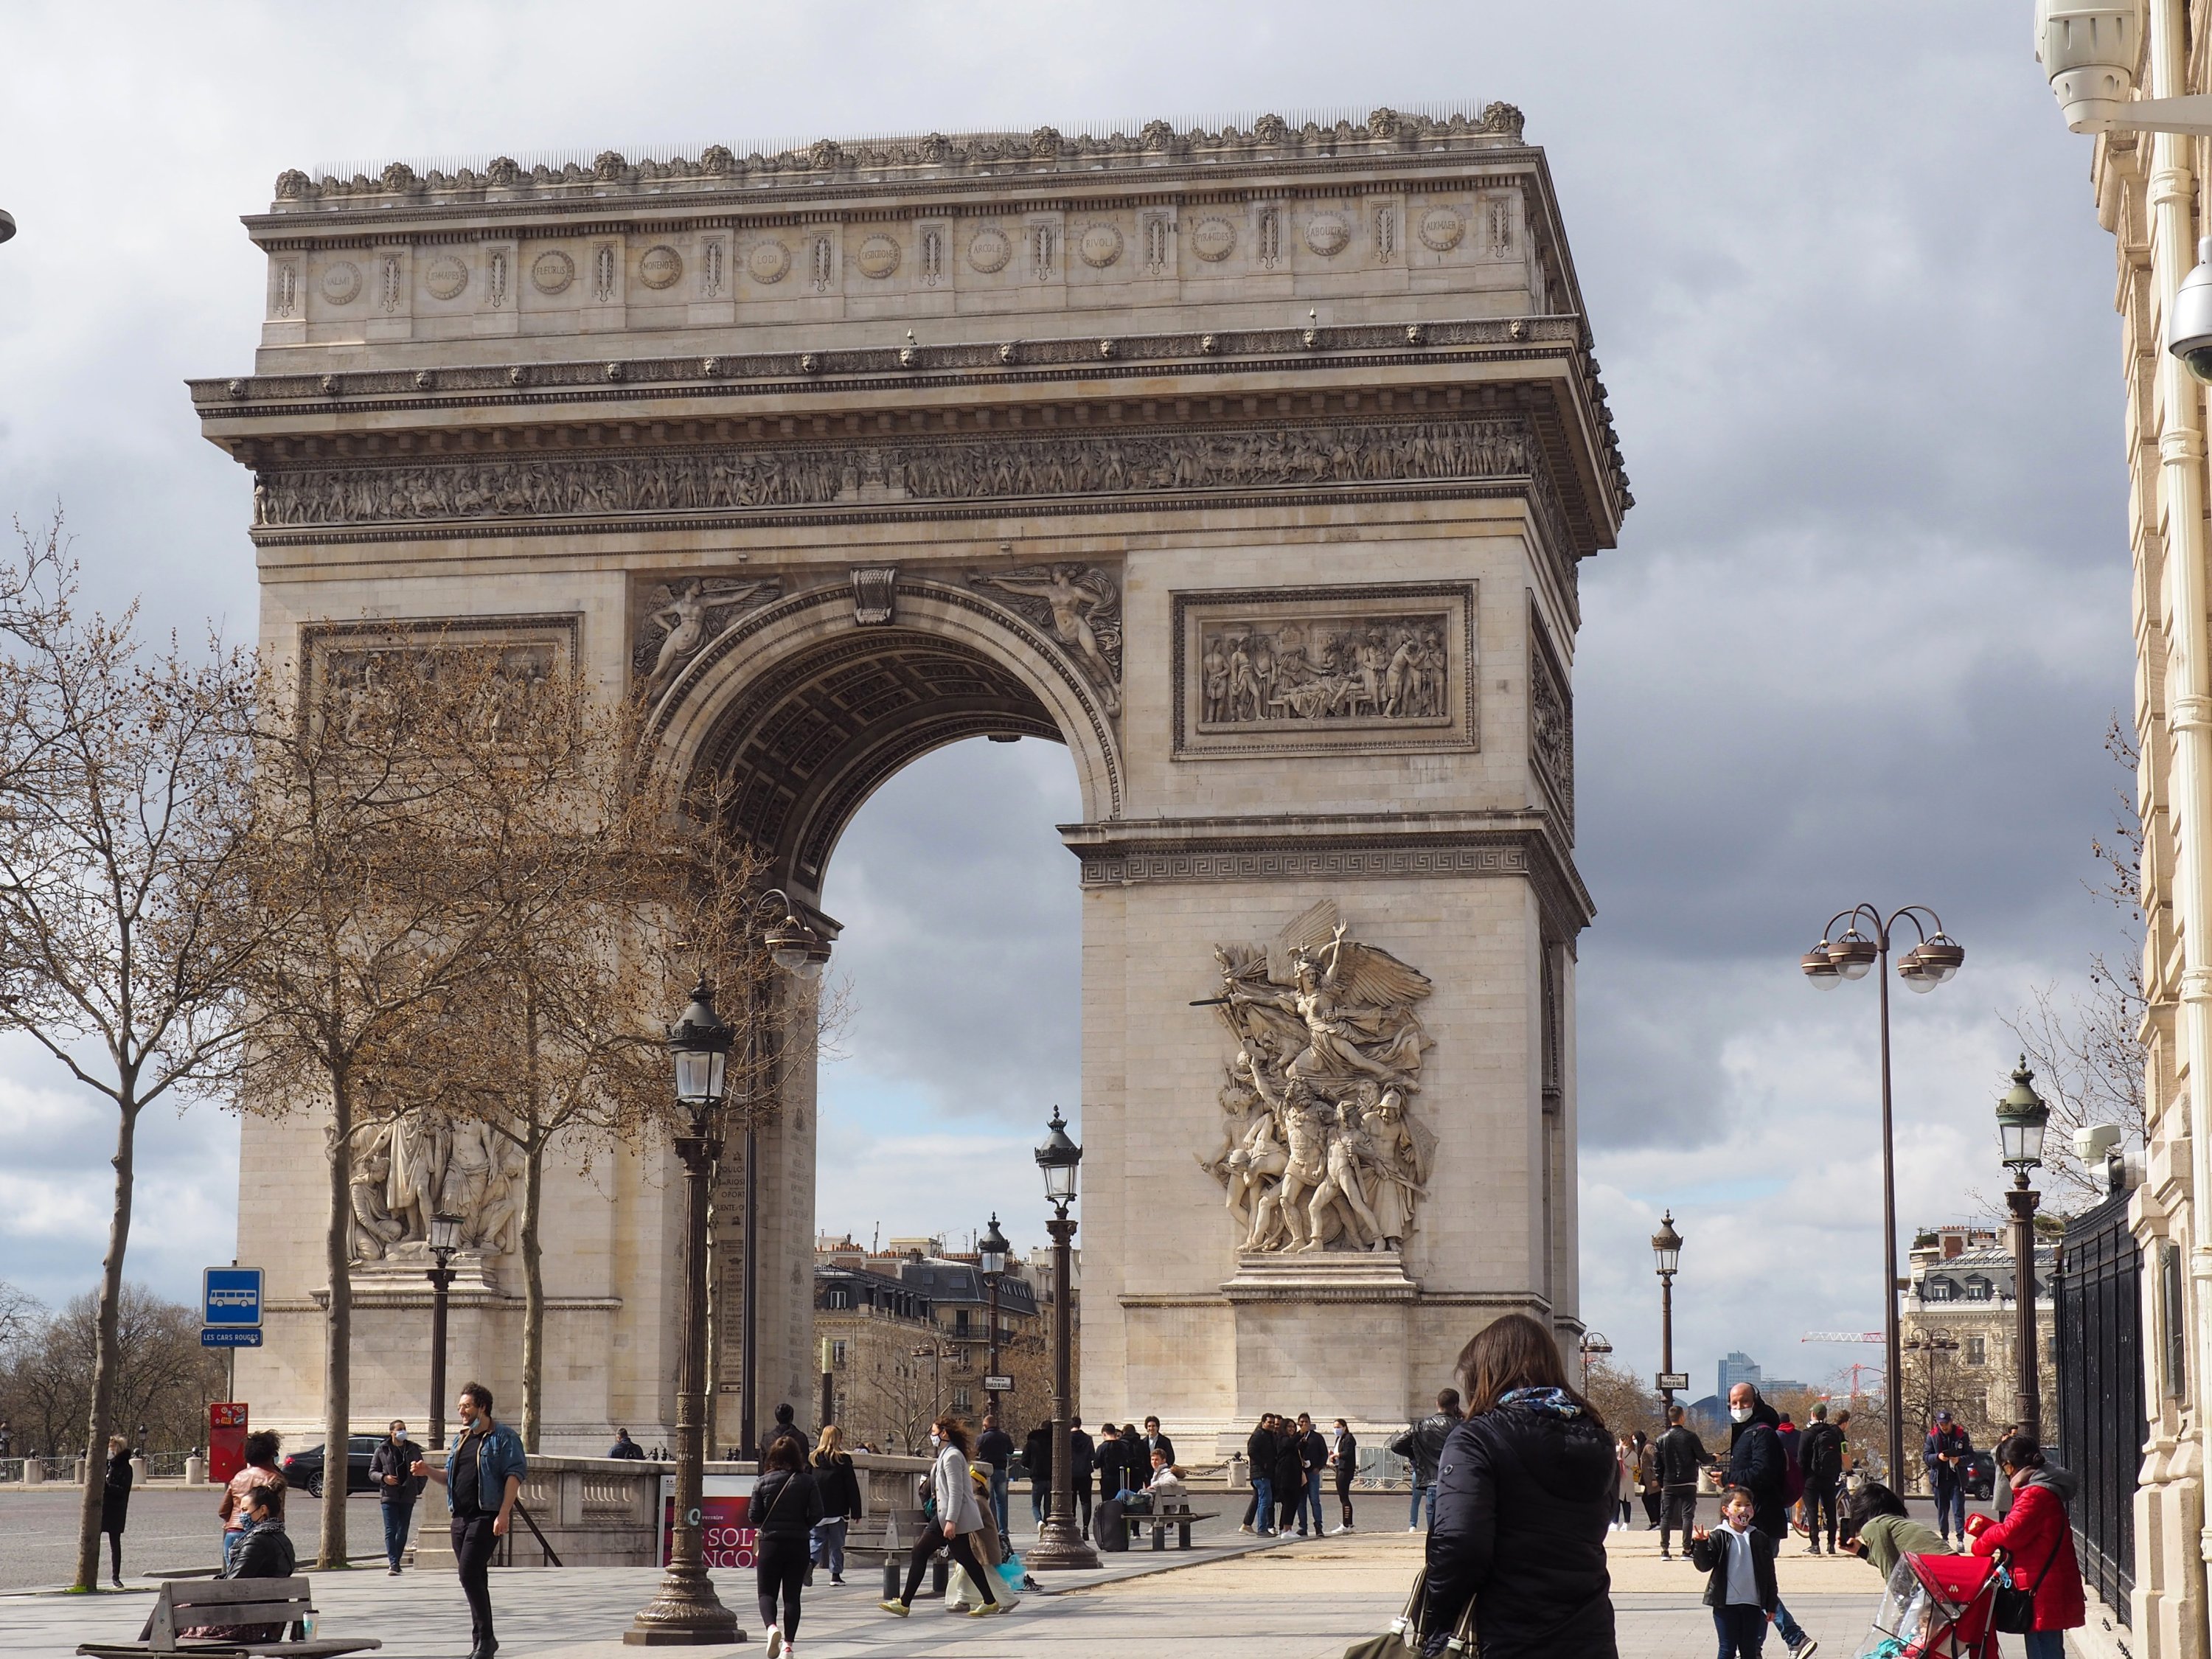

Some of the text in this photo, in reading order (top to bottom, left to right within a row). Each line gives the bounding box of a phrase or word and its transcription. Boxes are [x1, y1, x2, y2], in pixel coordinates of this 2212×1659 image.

[1310, 226, 1342, 236] ABOUKIR
[1086, 237, 1113, 248] RIVOLI
[973, 244, 1001, 254] ARCOLE
[757, 254, 777, 265] LODI
[536, 265, 567, 276] FLEURUS
